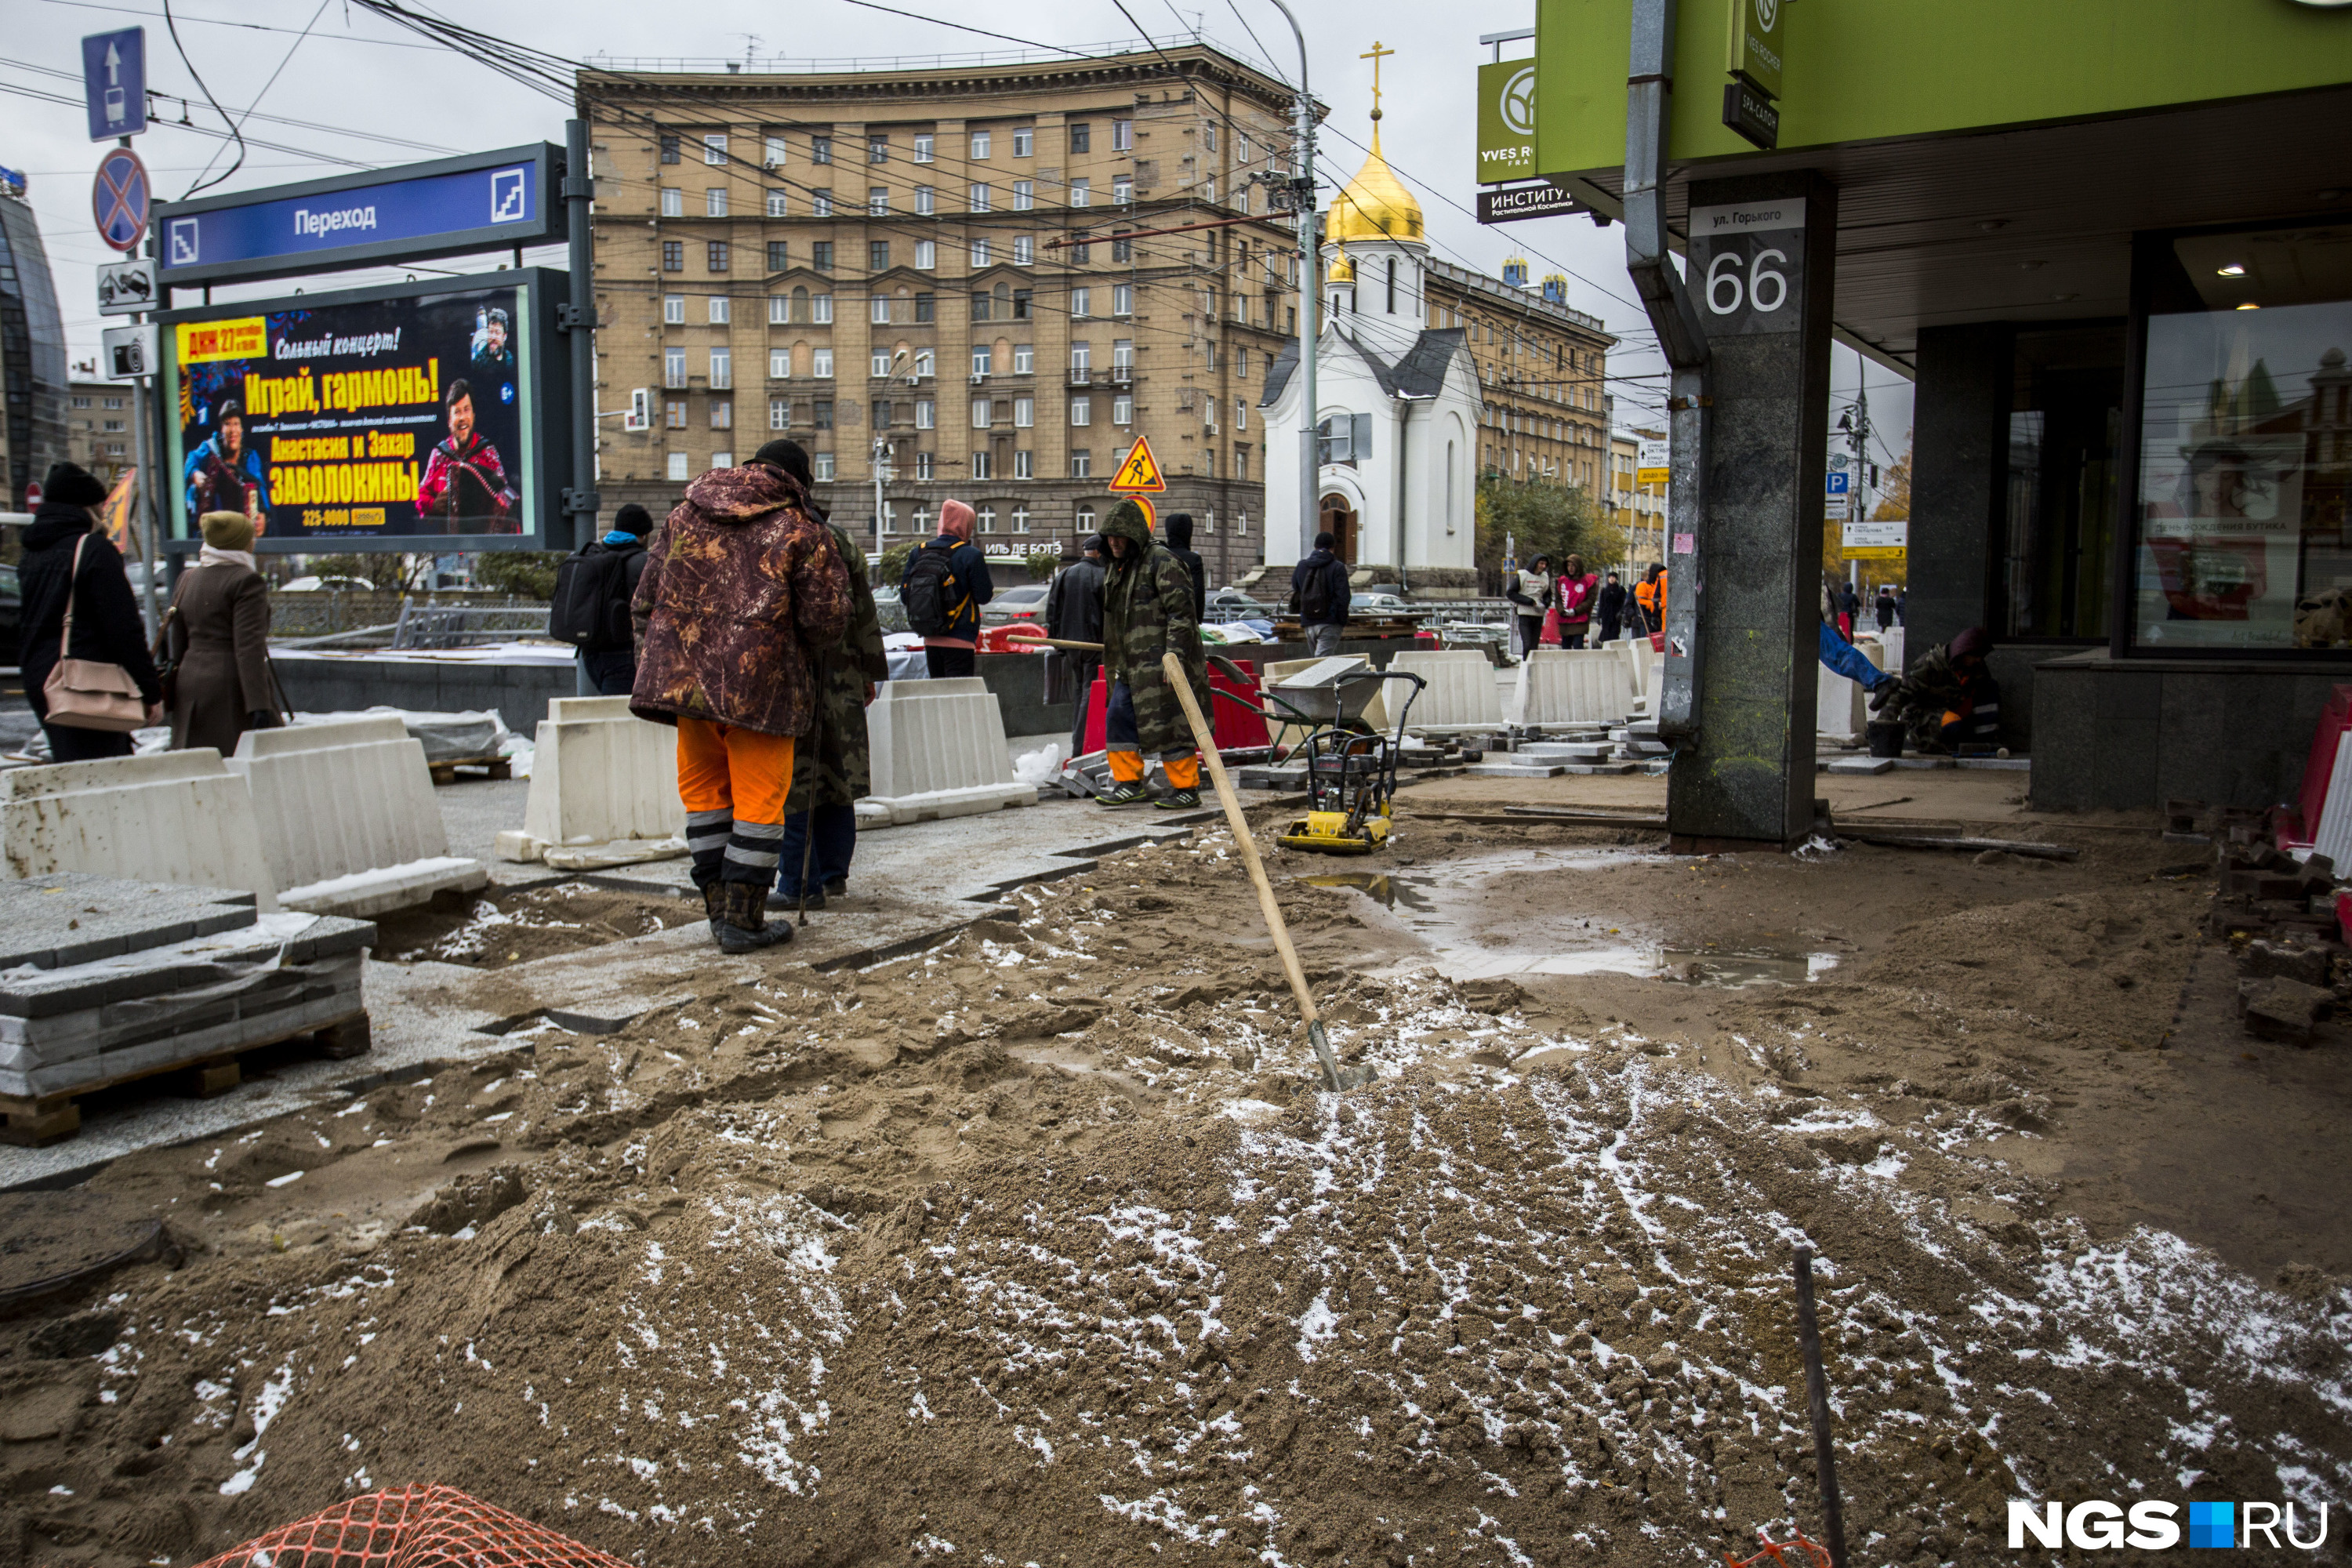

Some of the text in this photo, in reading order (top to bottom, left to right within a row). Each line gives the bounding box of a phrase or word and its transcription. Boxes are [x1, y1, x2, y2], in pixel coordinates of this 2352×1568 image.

[1746, 34, 1780, 72] YVES ROCHER
[1742, 93, 1777, 130] SPA-САЛОН
[1481, 146, 1534, 162] YVES R
[295, 206, 376, 238] Переход
[1492, 200, 1573, 216] Растительной Косметики
[1713, 211, 1781, 227] ул. Горького
[1706, 249, 1787, 315] 66
[220, 328, 234, 352] 27
[275, 332, 332, 361] Сольный
[333, 326, 401, 358] концерт!
[245, 358, 439, 418] Играй, гармонь!
[270, 430, 415, 463] Анастасия и Захар
[270, 460, 419, 506] ЗАВОЛОКИНЫ
[1831, 475, 1843, 492] P
[302, 509, 350, 527] 325-0000
[2155, 522, 2286, 533] ДЕНЬ РОЖДЕНИЯ БУТИКА
[985, 544, 1010, 554] ИЛЬ
[1011, 543, 1027, 554] ДЕ
